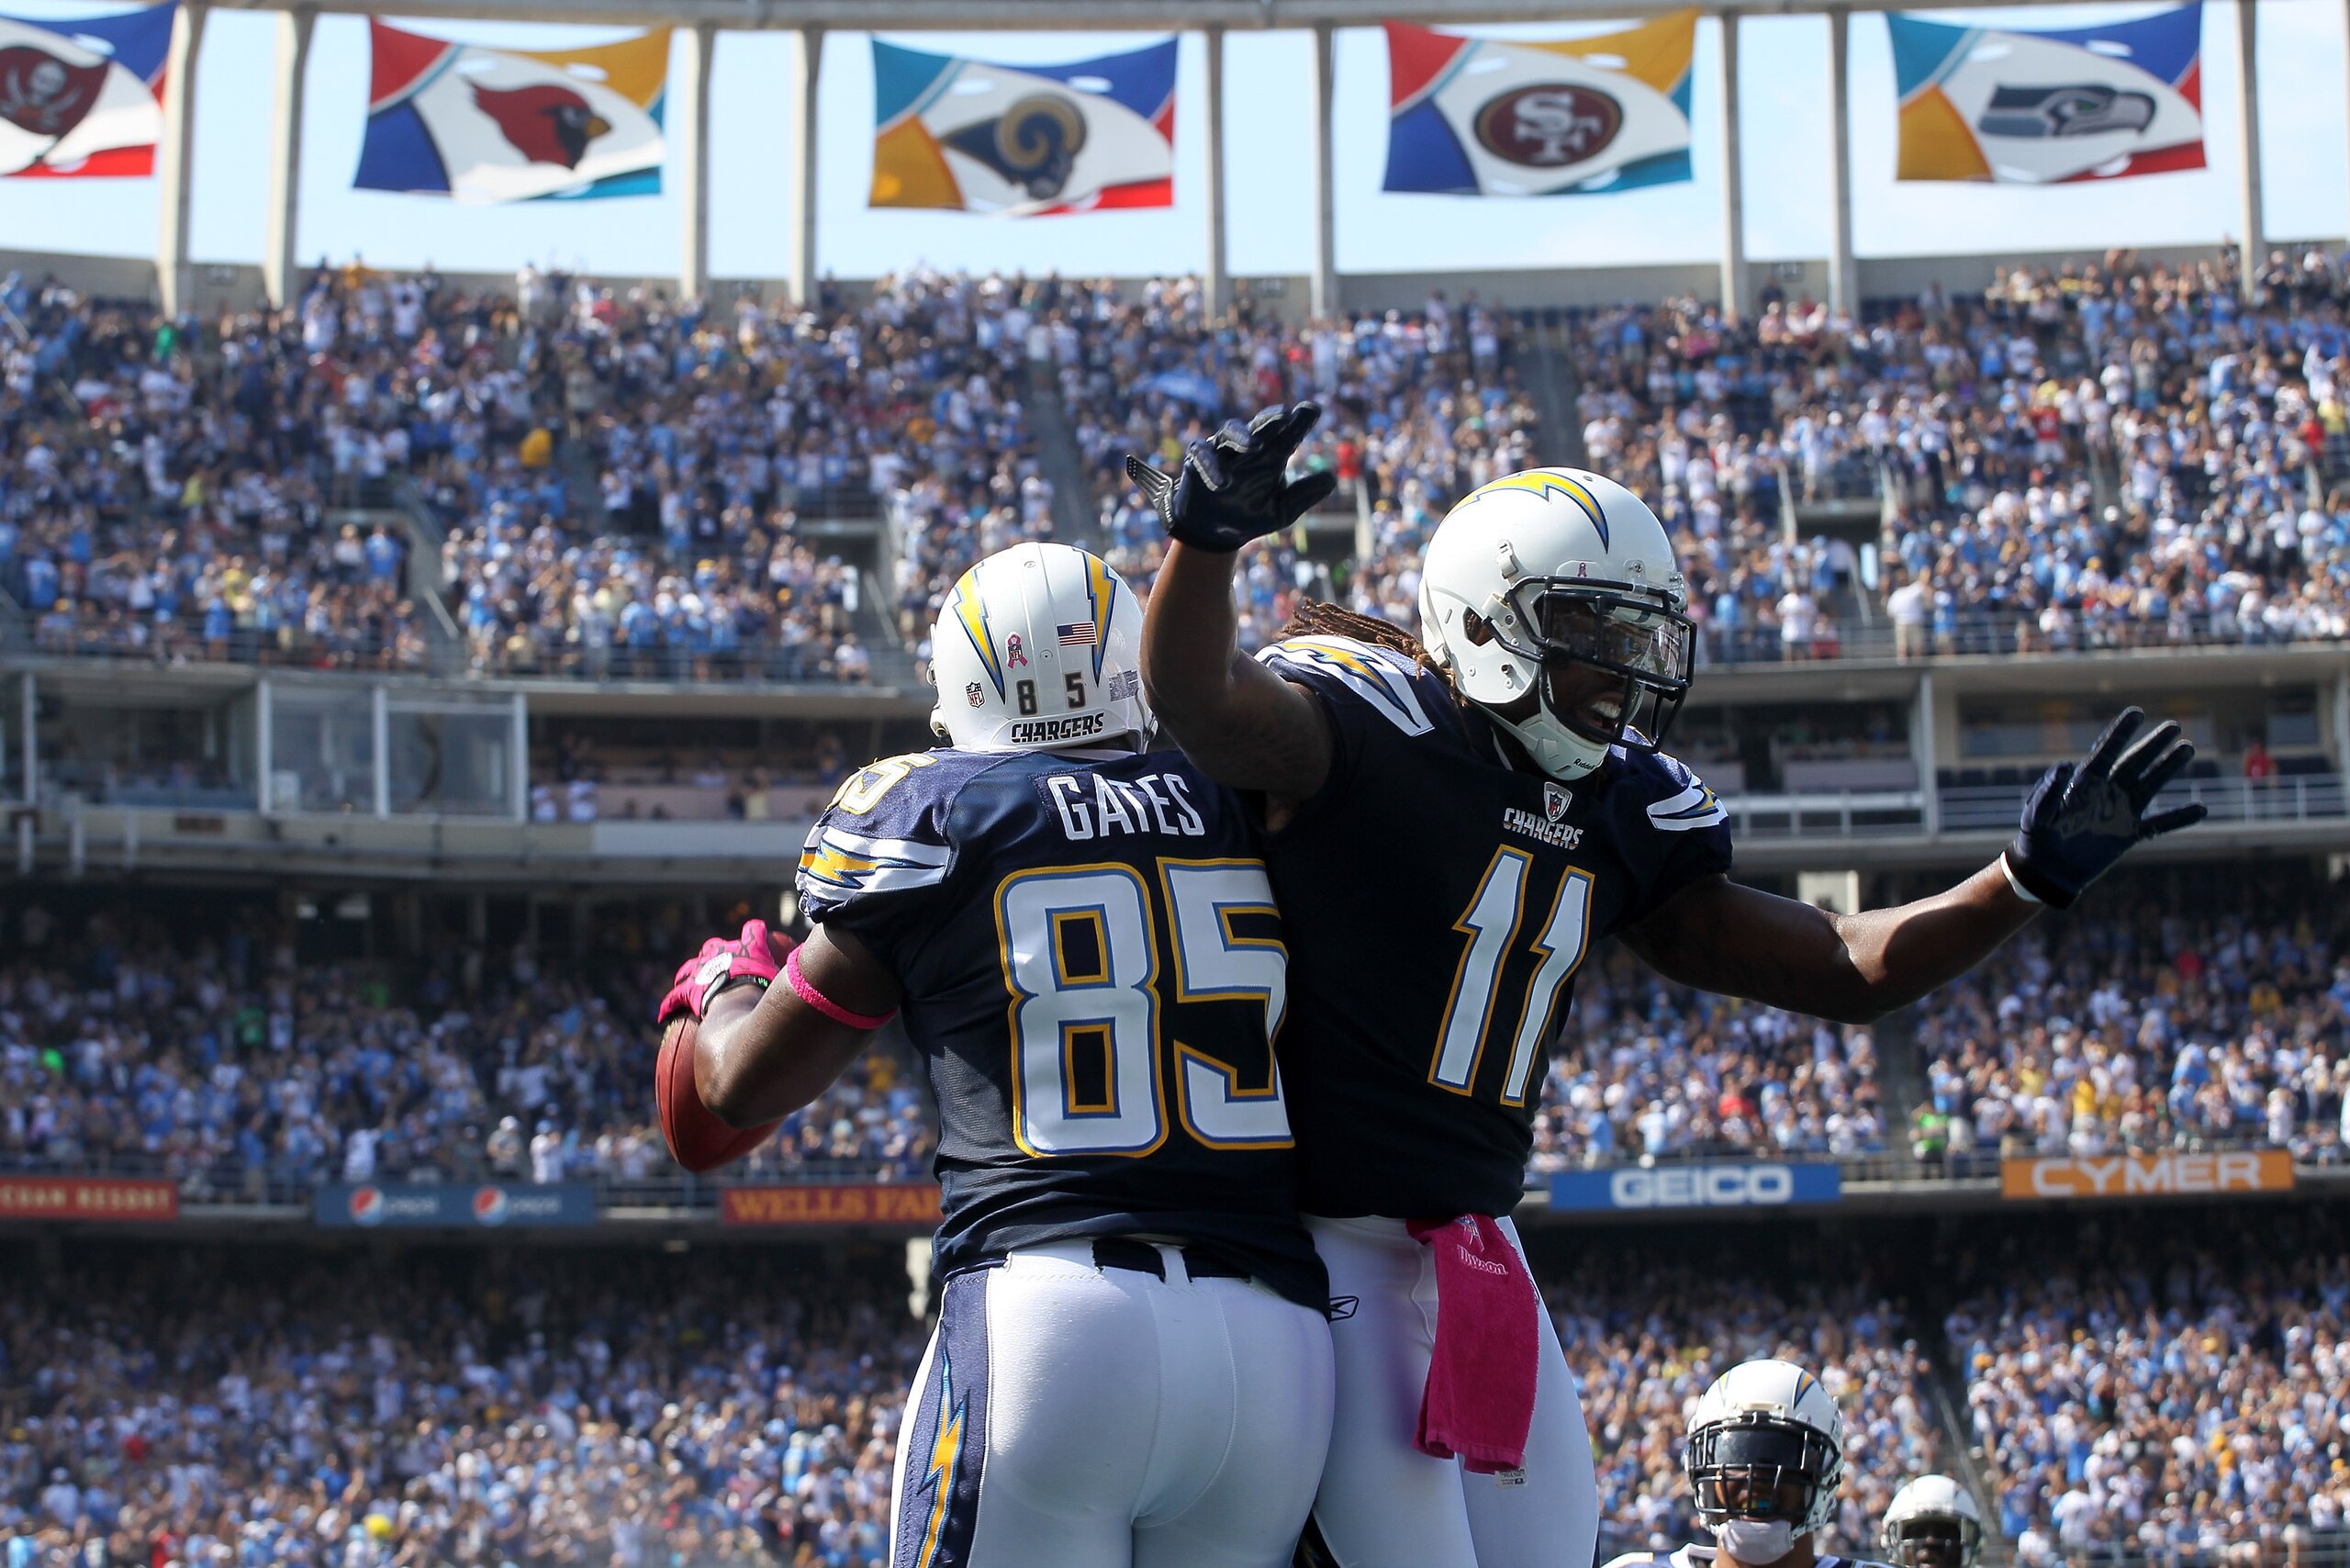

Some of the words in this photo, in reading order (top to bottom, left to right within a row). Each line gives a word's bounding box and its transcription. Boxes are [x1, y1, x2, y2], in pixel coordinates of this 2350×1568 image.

[1011, 712, 1104, 744] CHARGERS
[1046, 773, 1205, 840] GATES
[1503, 807, 1584, 850] CHARGERS
[1427, 843, 1595, 1108] 11
[993, 856, 1296, 1159] 85
[1609, 1163, 1794, 1209] GEICO
[2031, 1149, 2261, 1199] CYMER
[75, 1185, 172, 1212] RESORT
[731, 1187, 867, 1222] WELLS
